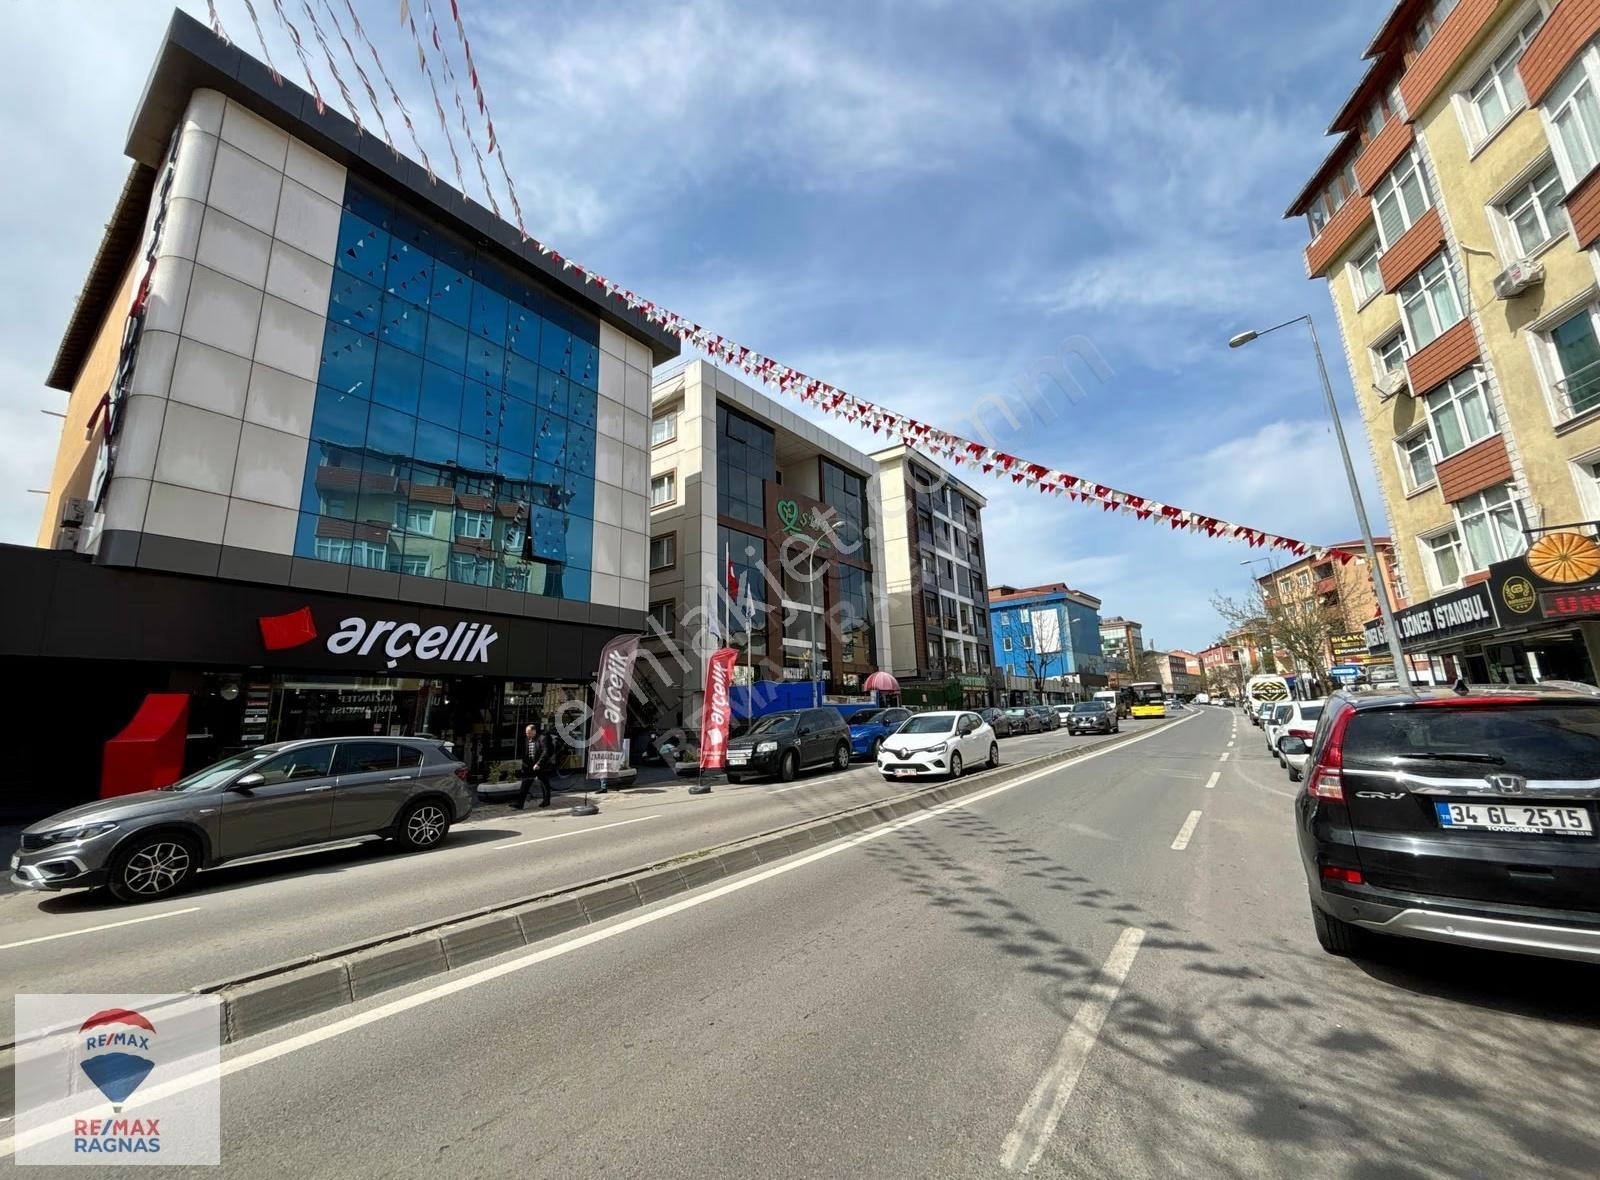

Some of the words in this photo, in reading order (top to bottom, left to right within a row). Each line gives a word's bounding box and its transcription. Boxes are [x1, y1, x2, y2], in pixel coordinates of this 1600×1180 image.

[1402, 610, 1434, 637] DÖNER
[1433, 594, 1489, 630] İSTANBUL
[327, 617, 498, 668] arçelik
[604, 650, 628, 724] arçelik
[711, 661, 730, 725] arçelik
[1355, 790, 1406, 800] CR-V
[1450, 805, 1478, 823] 34
[1487, 806, 1516, 825] GL
[1523, 808, 1583, 829] 2515
